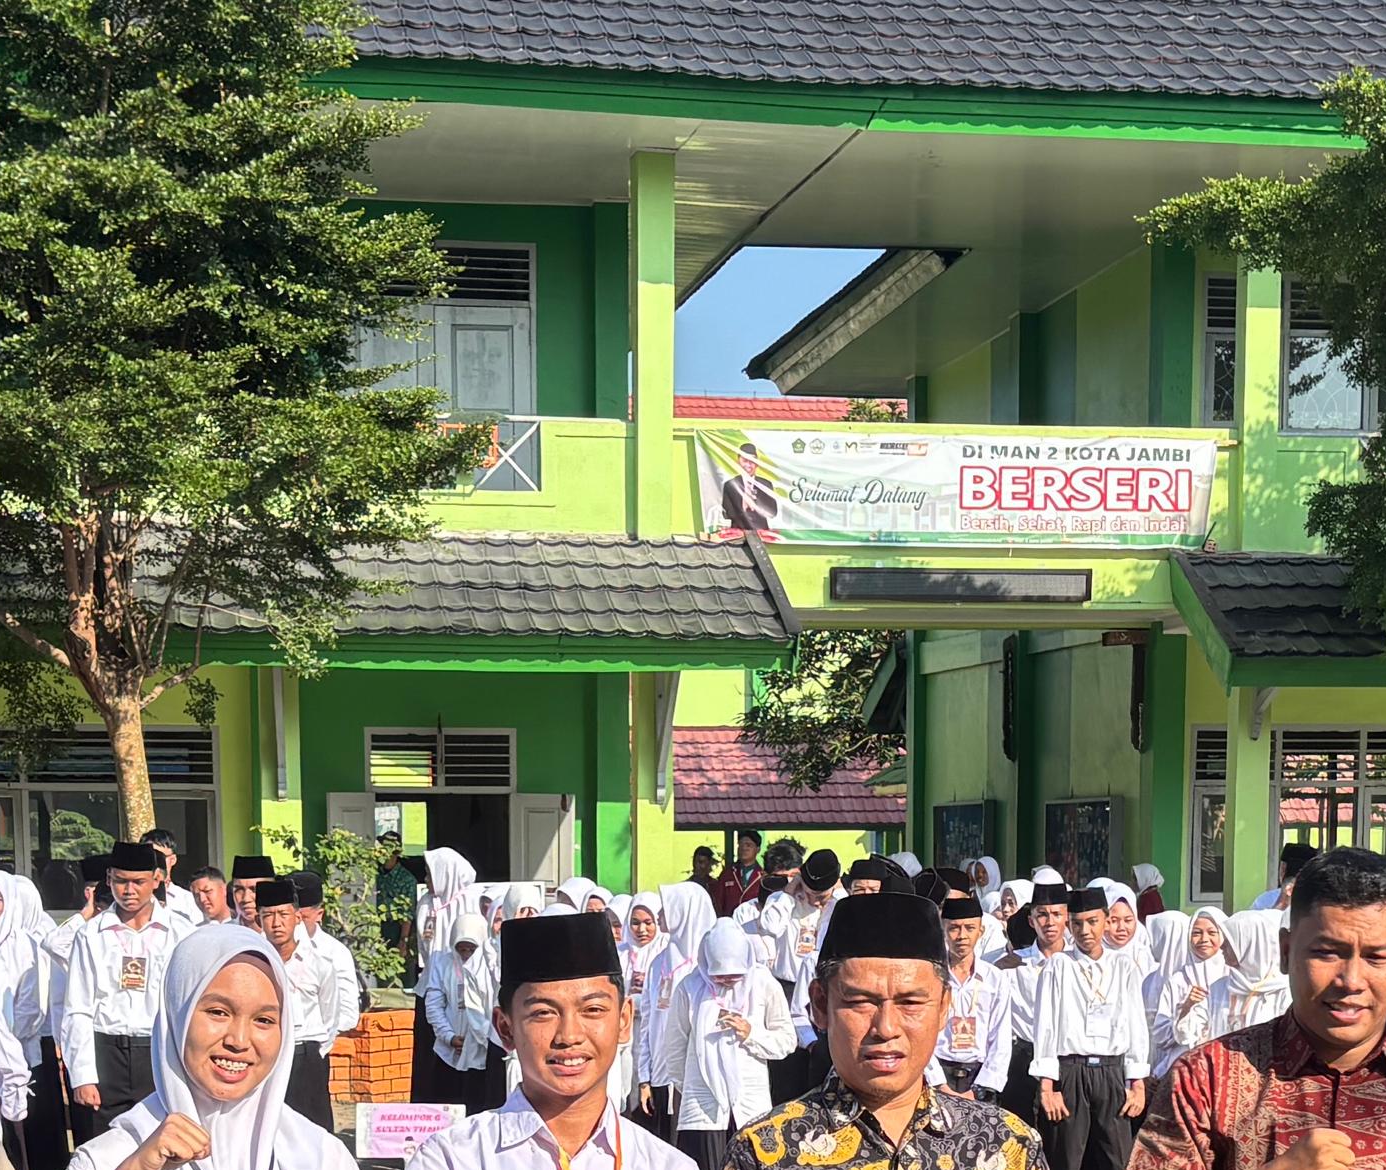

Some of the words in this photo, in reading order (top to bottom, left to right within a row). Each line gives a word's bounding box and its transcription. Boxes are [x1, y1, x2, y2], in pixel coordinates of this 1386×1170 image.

[962, 445, 983, 459] DI
[990, 445, 1040, 461] MAN
[1047, 446, 1059, 461] 2
[1065, 447, 1121, 462] KOTA
[1126, 447, 1191, 463] JAMBI
[859, 478, 929, 511] Datang
[959, 465, 1193, 513] BERSERI
[1071, 516, 1107, 535] Rapi
[1110, 516, 1141, 533] dan
